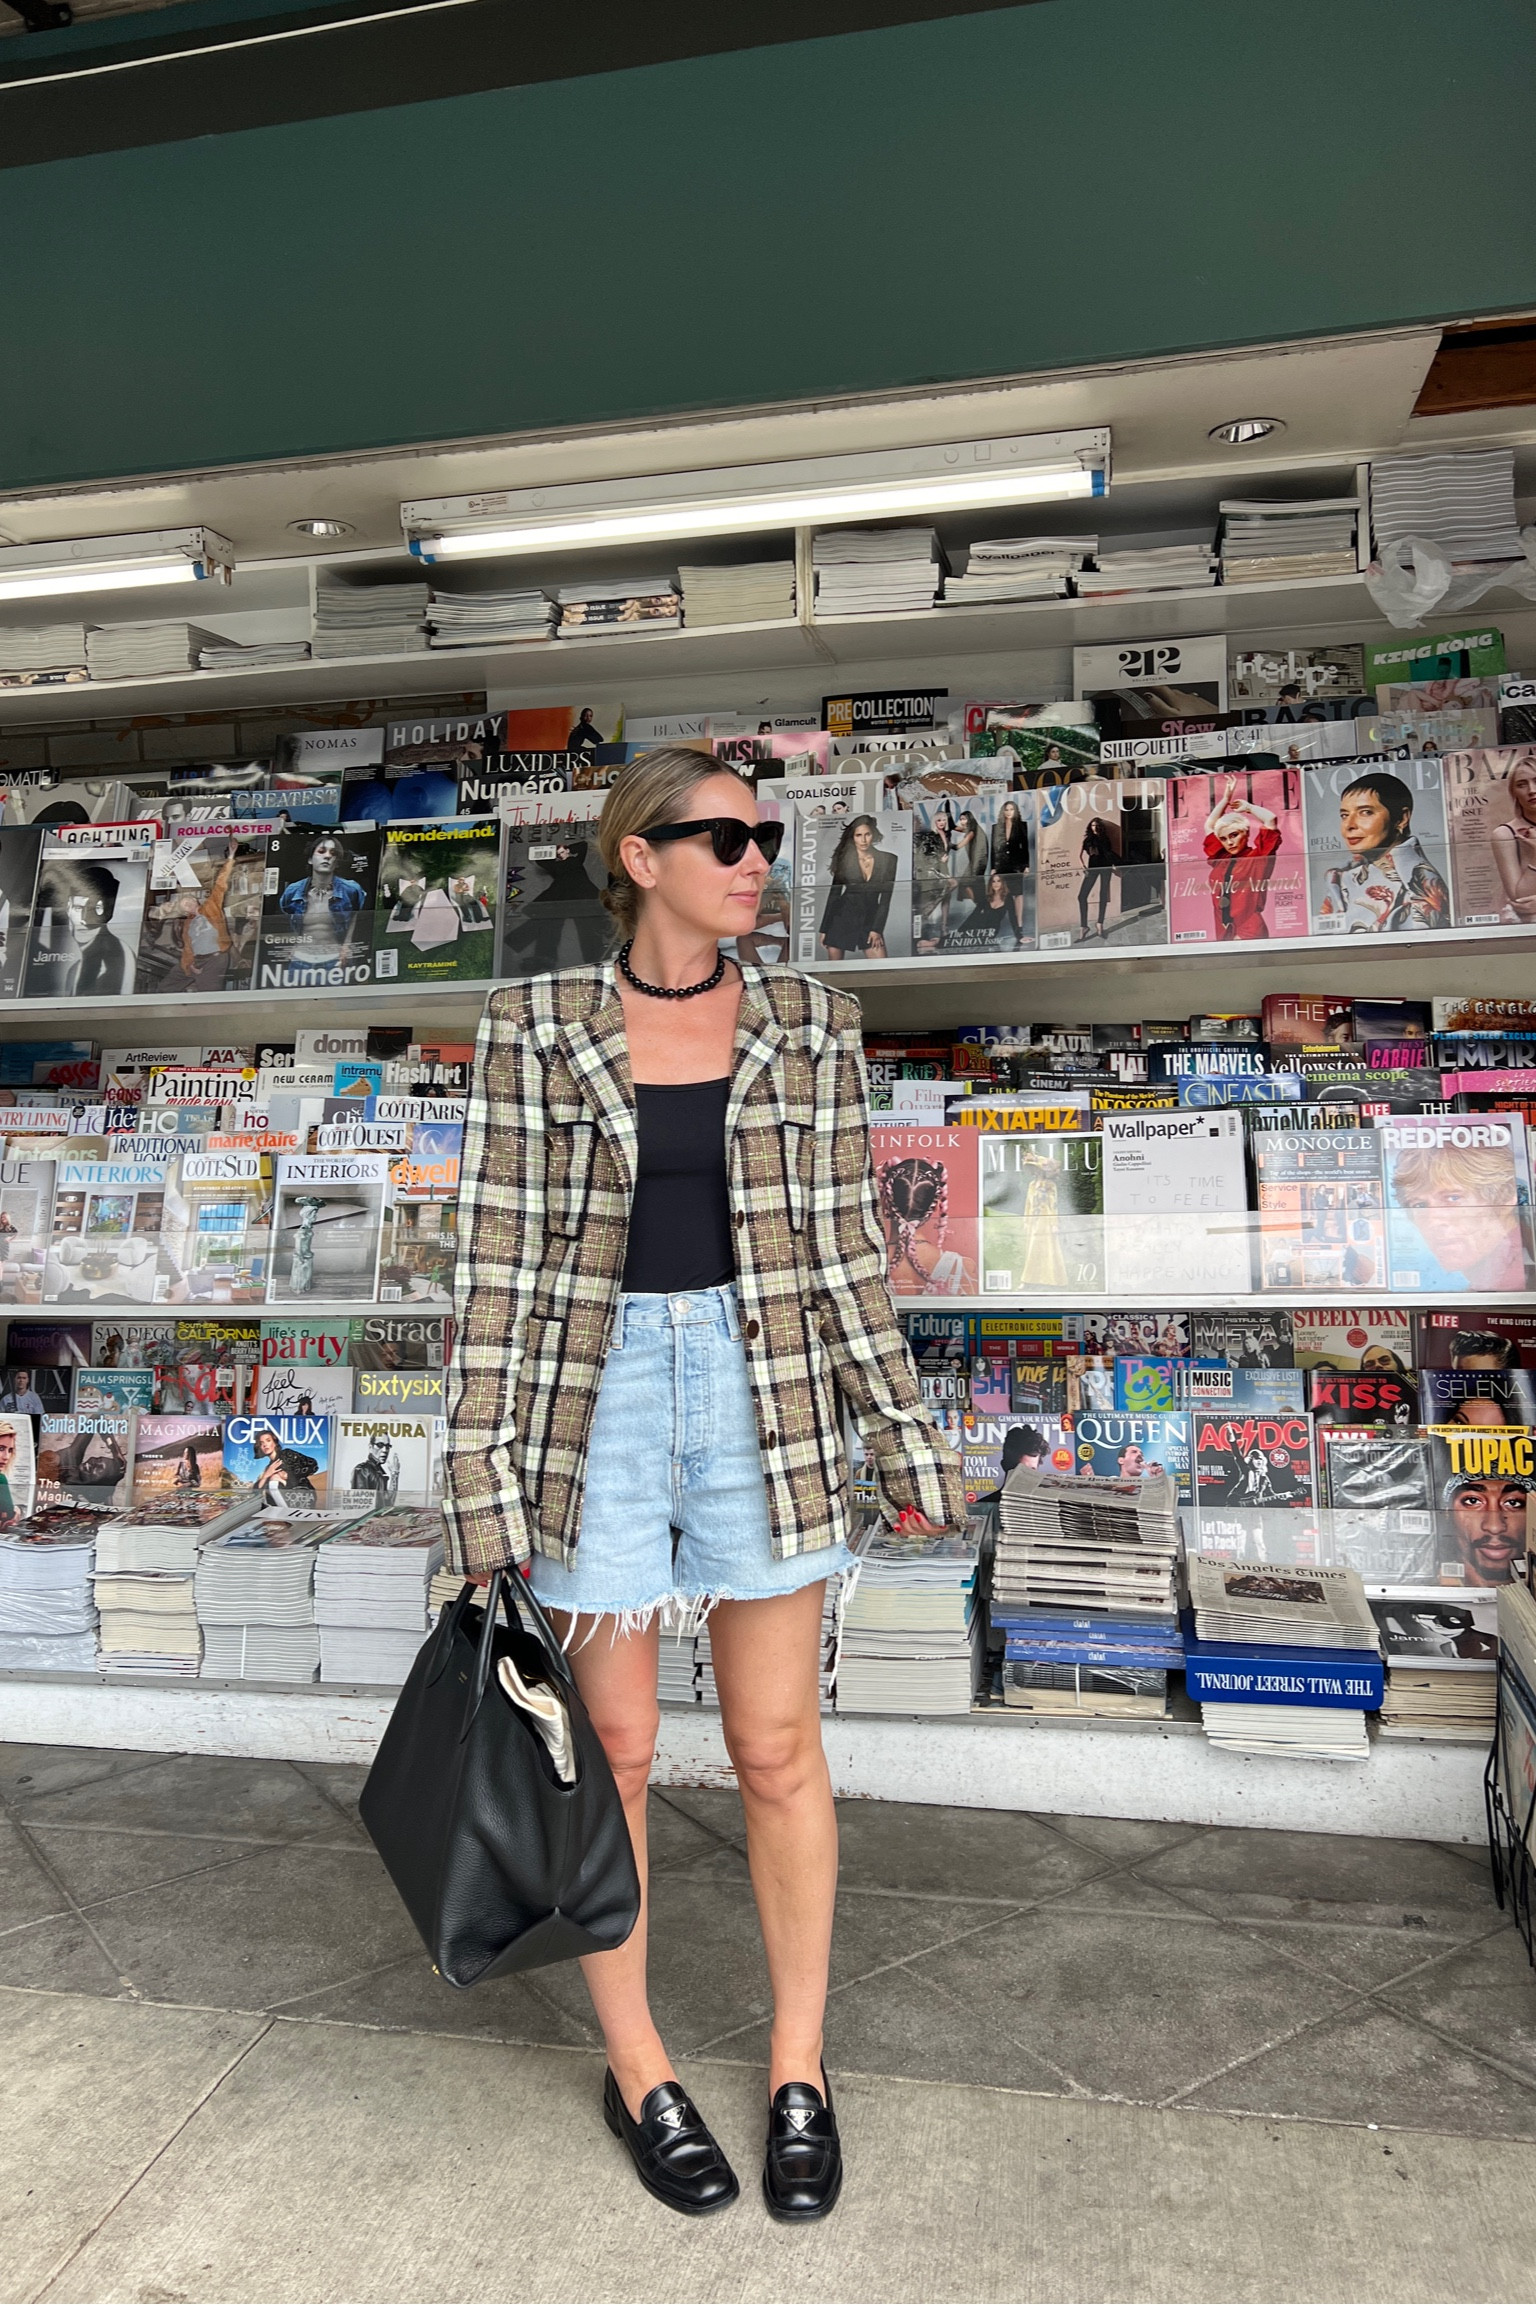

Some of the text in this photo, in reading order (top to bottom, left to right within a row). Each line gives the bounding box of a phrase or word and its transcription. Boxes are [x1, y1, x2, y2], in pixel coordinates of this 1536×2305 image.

[1374, 633, 1492, 665] KING KONG
[1118, 647, 1181, 677] 212
[1244, 696, 1376, 725] BASIC
[774, 717, 817, 728] Glamcult
[1161, 720, 1216, 736] New
[393, 717, 502, 746] HOLIDAY
[305, 737, 357, 750] NOMAS
[1104, 737, 1188, 759] SILHOUETTE
[485, 751, 592, 773] LUXIDERS
[460, 775, 565, 801] Numéro
[786, 786, 857, 799] ODALISQUE
[1171, 771, 1300, 819] ELLE
[1463, 787, 1480, 795] THE
[236, 789, 339, 809] GREATEST
[1039, 779, 1164, 820] VOGUE
[1461, 808, 1483, 817] ISSUE
[177, 823, 273, 837] ROLLACOASTER
[271, 840, 280, 851] 8
[1310, 835, 1338, 846] BELLA
[800, 814, 818, 931] NEWBEAUTY
[264, 933, 313, 944] Genesis
[965, 928, 996, 937] SUPER
[33, 950, 76, 963] James
[260, 958, 371, 988] Numéro
[1278, 1003, 1326, 1022] THE
[1439, 1002, 1470, 1014] THE
[125, 1052, 178, 1063] ArtReview
[1163, 1052, 1264, 1076] THE MARVELS
[1371, 1048, 1425, 1068] CARRIE
[272, 1074, 334, 1084] NEW CERAM
[386, 1063, 462, 1085] Flash Art
[1305, 1070, 1410, 1083] cinema scope
[151, 1073, 256, 1102] Painting
[1184, 1082, 1292, 1106] CINEASTE
[1361, 1103, 1390, 1116] LIFE
[29, 1111, 67, 1128] LIVING
[952, 1106, 1078, 1132] JUXTAPOZ
[208, 1131, 298, 1148] marie claire
[869, 1134, 961, 1149] KINFOLK
[1266, 1136, 1373, 1151] MONOCLE
[1384, 1126, 1511, 1149] REDFORD
[986, 1141, 1101, 1174] MILIEU
[1112, 1153, 1145, 1162] Anohni
[65, 1166, 163, 1184] INTERIORS
[286, 1163, 380, 1179] INTERIORS
[389, 1157, 458, 1185] dwell
[1189, 1175, 1225, 1188] TIME
[1261, 1183, 1298, 1192] Service
[1174, 1193, 1226, 1207] FEEL
[1261, 1200, 1287, 1209] Style
[427, 1231, 455, 1240] THIS IS
[439, 1240, 456, 1249] THE
[1076, 1263, 1097, 1282] 10
[177, 1322, 220, 1330] SOUTHERN
[986, 1318, 1063, 1332] ELECTRONIC SOUND
[1293, 1309, 1410, 1329] STEELY DAN
[1431, 1314, 1460, 1328] LIFE
[1487, 1317, 1532, 1326] THE KING LIVES
[95, 1326, 176, 1341] SAN DIEGO
[268, 1327, 310, 1339] life's a
[364, 1318, 445, 1343] Strad
[262, 1332, 349, 1367] party
[80, 1375, 147, 1384] PALM SPRINGS
[1016, 1365, 1049, 1384] VIVE
[1192, 1371, 1232, 1387] MUSIC
[1245, 1371, 1299, 1381] EXCLUSIVE LIST!
[360, 1373, 443, 1403] Sixtysix
[1192, 1388, 1232, 1397] CONNECTION
[1436, 1379, 1527, 1399] SELENA
[1311, 1383, 1402, 1410] KISS
[41, 1414, 129, 1435] Santa Barbara
[1021, 1415, 1040, 1423] YOUR
[139, 1423, 220, 1437] MAGNOLIA
[227, 1417, 325, 1445] GENLUX
[340, 1421, 427, 1439] TEMPURA
[965, 1422, 1067, 1446] UNUT
[1076, 1418, 1189, 1449] QUEEN
[963, 1456, 988, 1467] TOM
[1446, 1437, 1536, 1475] TUPAC
[963, 1467, 999, 1478] WAITS
[39, 1478, 61, 1489] The
[37, 1491, 73, 1504] Magic
[285, 1492, 315, 1501] SOPHIA
[353, 1498, 373, 1506] MODE
[355, 1491, 375, 1499] JAPON
[855, 1491, 878, 1504] The
[1201, 1520, 1243, 1535] Let There
[1201, 1536, 1214, 1550] Be
[1197, 1556, 1348, 1581] Los Angeles Times
[1255, 1675, 1305, 1693] STREET
[1306, 1677, 1343, 1695] WALL
[1345, 1679, 1374, 1696] THE
